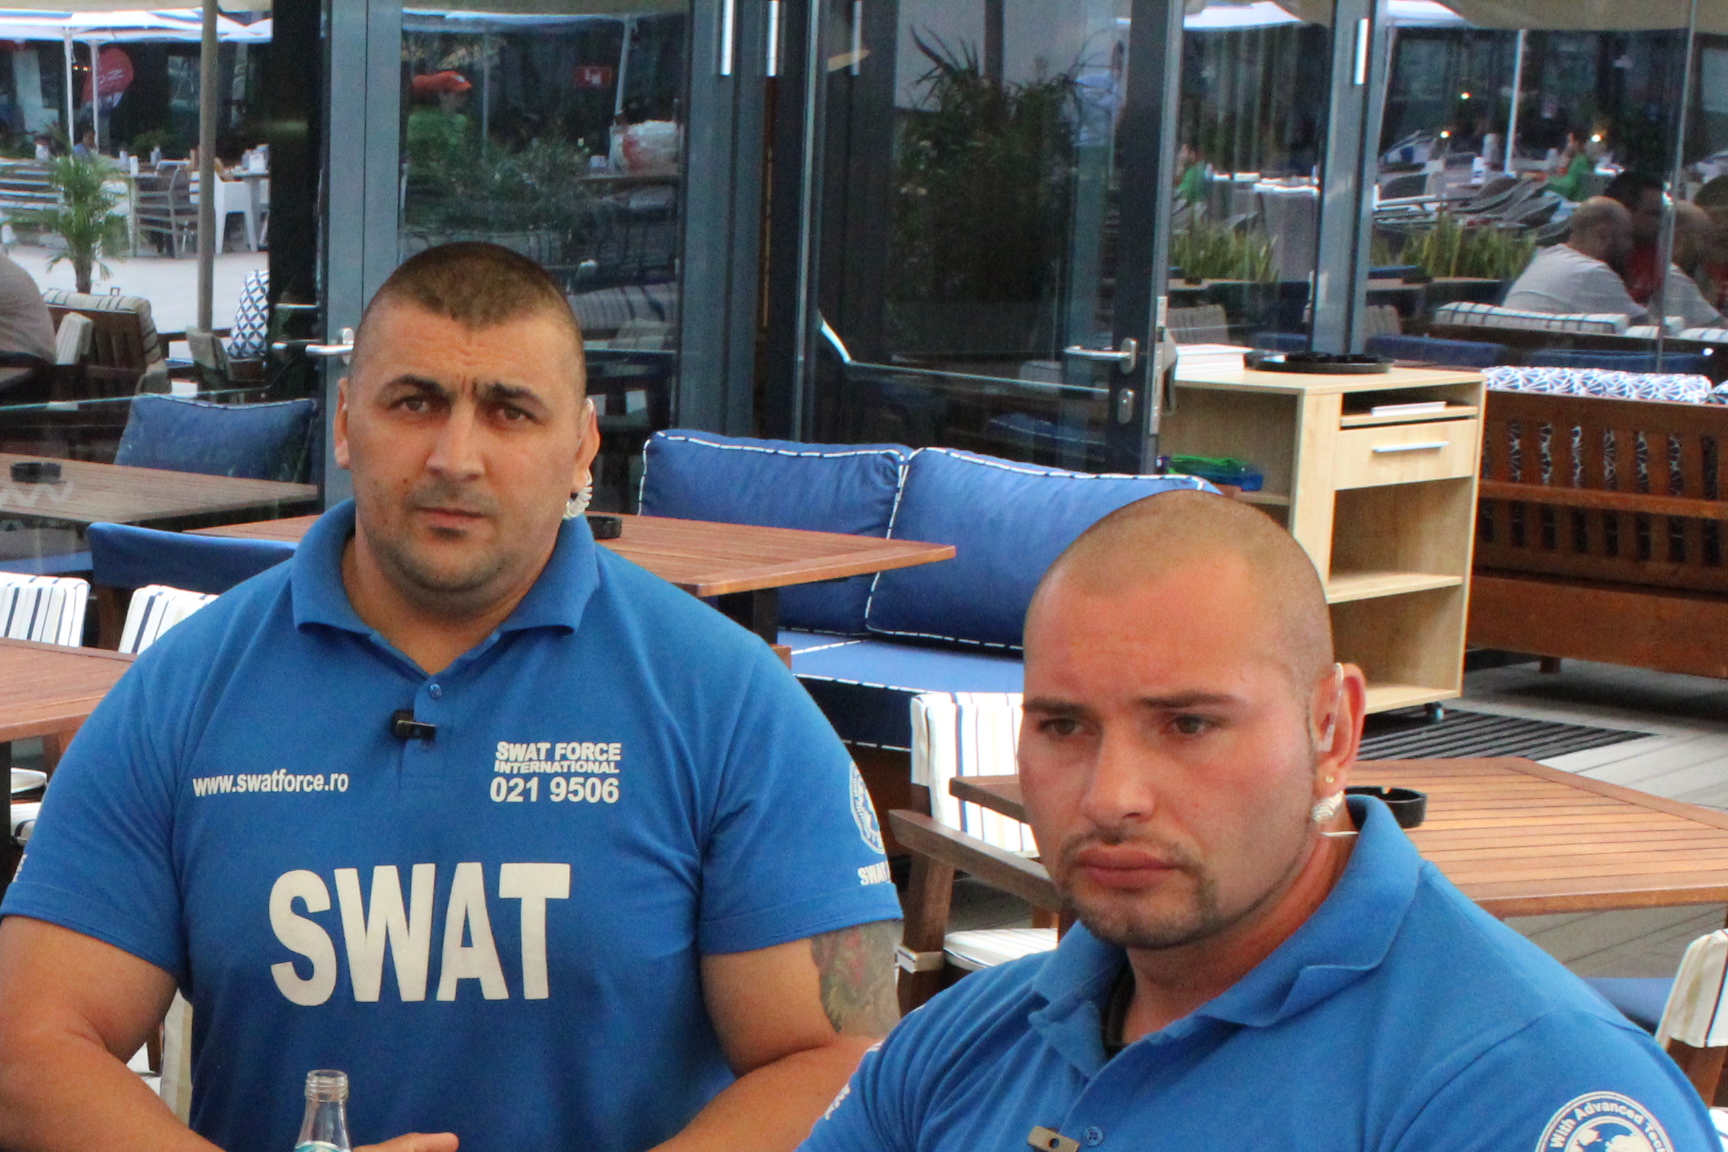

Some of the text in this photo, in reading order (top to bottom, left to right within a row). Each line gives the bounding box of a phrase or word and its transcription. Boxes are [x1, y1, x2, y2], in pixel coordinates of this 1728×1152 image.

[495, 741, 622, 762] SWAT FORCE
[493, 759, 620, 775] INTERNATIONAL
[192, 768, 349, 798] www.swatforce.ro
[489, 776, 620, 804] 021 9506
[269, 861, 571, 1007] SWAT
[1549, 1118, 1577, 1148] With
[1573, 1101, 1645, 1126] Advanced
